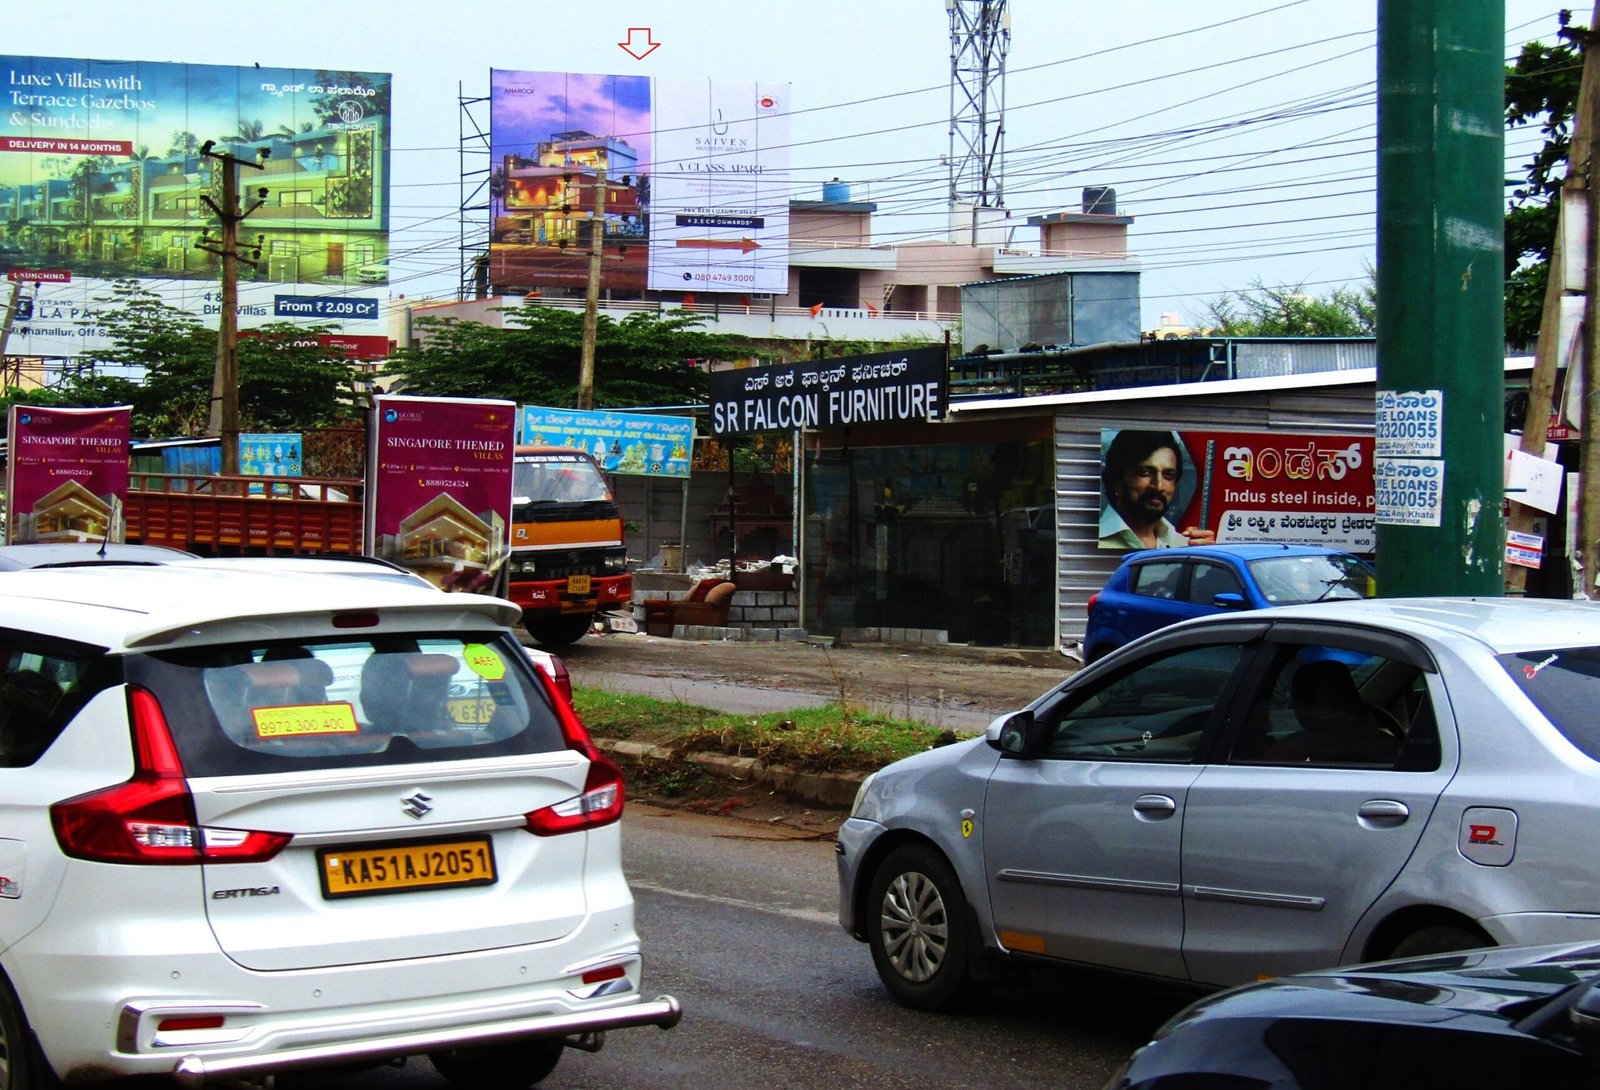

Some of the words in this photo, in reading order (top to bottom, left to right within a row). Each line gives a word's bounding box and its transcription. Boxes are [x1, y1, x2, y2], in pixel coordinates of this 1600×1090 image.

[10, 70, 51, 86] Luxe
[55, 72, 101, 89] Villas
[104, 75, 142, 90] with
[9, 90, 77, 107] Terrace
[80, 94, 156, 111] Gazebos
[9, 111, 27, 127] &
[9, 140, 55, 150] DELIVERY
[57, 142, 68, 150] IN
[69, 143, 79, 151] 14
[80, 143, 122, 152] MONTHS
[695, 137, 747, 146] SAIVEN
[677, 162, 684, 172] A
[688, 163, 725, 173] CLASS
[13, 272, 65, 280] LAUNCHING
[203, 292, 212, 302] 4
[236, 306, 267, 316] Villas
[279, 300, 312, 312] From
[326, 302, 353, 313] 2.09
[40, 308, 63, 319] LA
[77, 328, 95, 337] Off
[714, 401, 739, 434] SR
[744, 393, 819, 431] FALCON
[829, 382, 939, 424] FURNITURE
[1390, 411, 1438, 421] LOANS
[22, 436, 77, 446] SINGAPORE
[80, 437, 121, 446] THEMED
[387, 437, 452, 449] SINGAPORE
[454, 439, 505, 451] THEMED
[1392, 441, 1406, 449] Any
[473, 452, 504, 460] VILLAS
[1223, 441, 1362, 481] ಇಂಡಸ್
[425, 479, 469, 487] 8880524524
[1391, 479, 1438, 491] LOANS
[1224, 489, 1266, 502] Indus
[1271, 490, 1307, 504] steel
[1312, 491, 1361, 508] inside,
[1392, 510, 1406, 518] Any
[1407, 511, 1435, 519] Khata
[1227, 514, 1242, 531] ಶ್ರೀ
[1247, 516, 1275, 534] ಲಕ್ಷ್ಮೀ
[1280, 516, 1337, 535] ವೆಂಕಟೇಶ್ವರ
[462, 704, 494, 721] 6315
[260, 720, 292, 734] 9972
[296, 719, 318, 732] 300
[323, 718, 345, 730] 400
[342, 847, 488, 885] KA51AJ2051
[212, 885, 280, 900] ERTIGA
